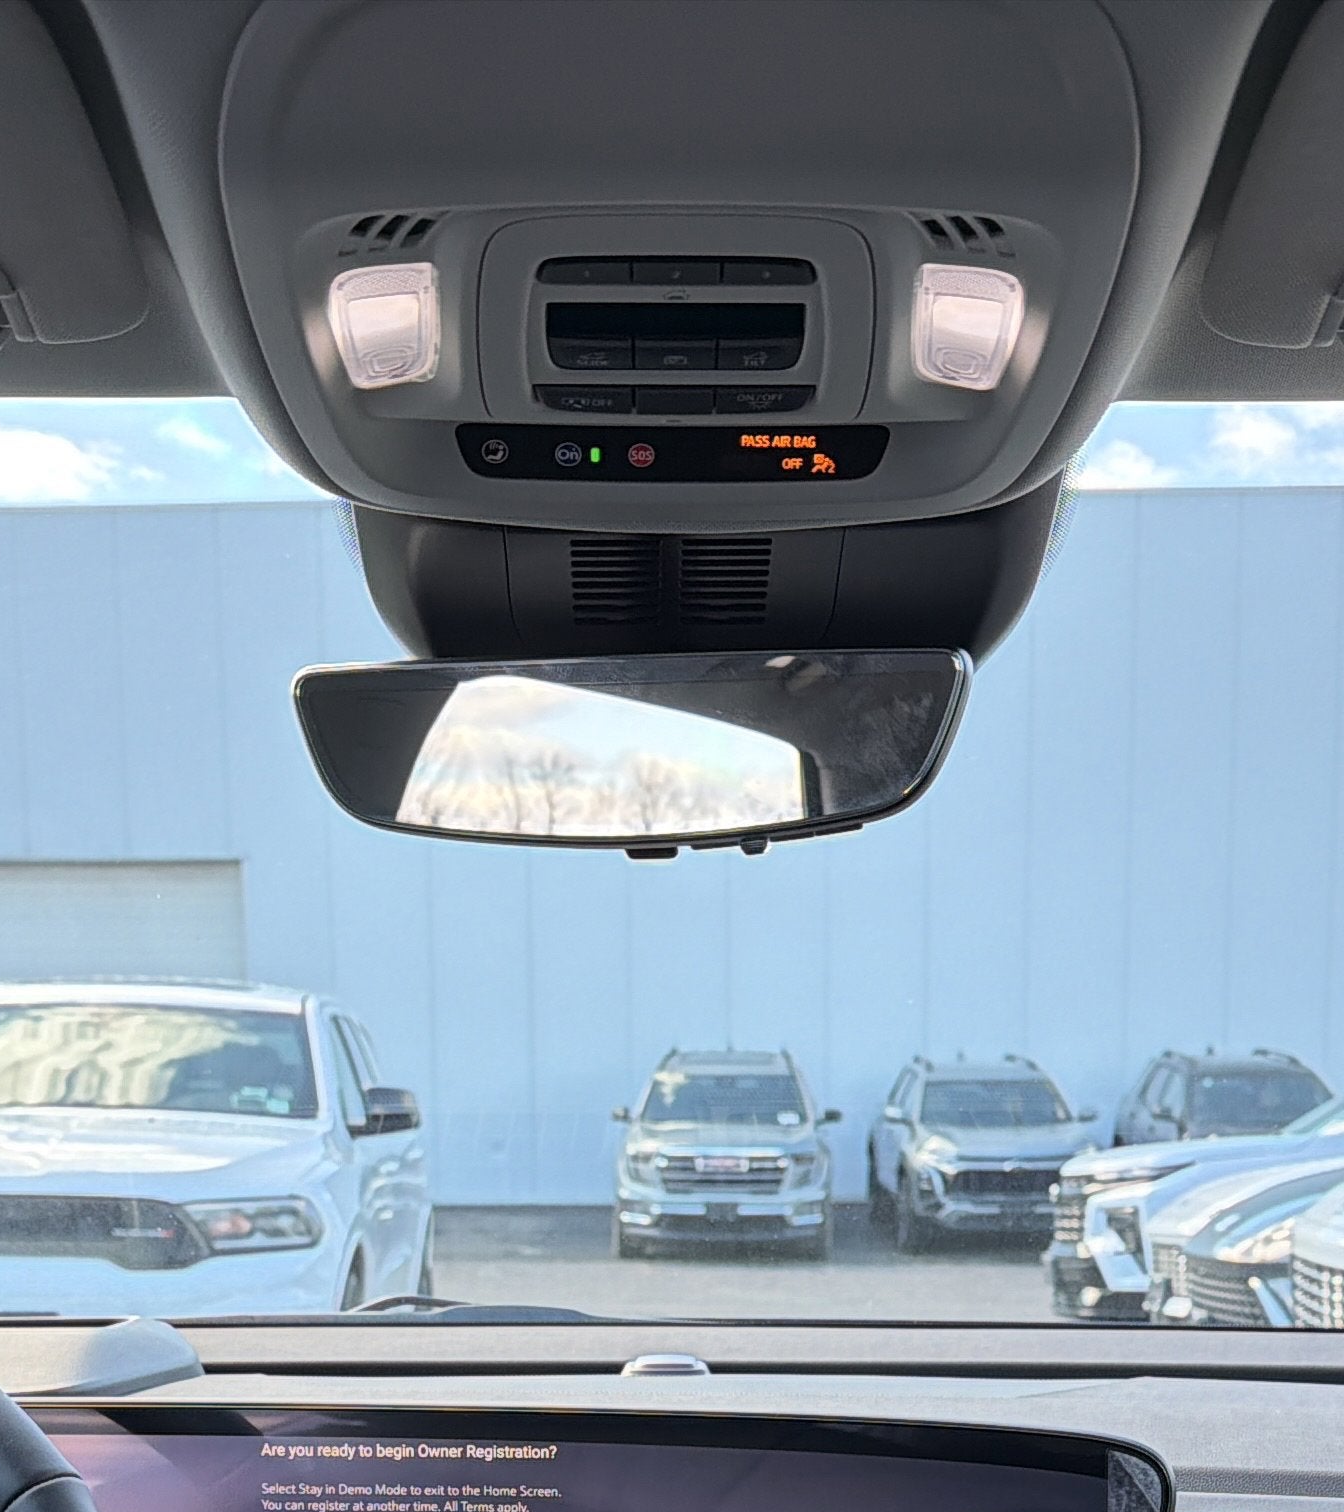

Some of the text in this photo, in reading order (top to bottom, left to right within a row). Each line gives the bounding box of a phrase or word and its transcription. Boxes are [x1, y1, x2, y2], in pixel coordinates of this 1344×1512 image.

[741, 434, 817, 449] PASS AIR BAG
[631, 449, 653, 462] SOS
[782, 457, 803, 471] OFF
[261, 1443, 558, 1462] Are you ready to begin Owner Registration?
[262, 1482, 562, 1498] Select Stay in Demo Mode to exit to the Home Screen.
[262, 1500, 282, 1512] You
[285, 1502, 305, 1511] can
[353, 1502, 365, 1512] at
[367, 1501, 411, 1512] another
[413, 1501, 441, 1512] time.
[444, 1501, 459, 1512] All
[461, 1501, 495, 1512] Terms
